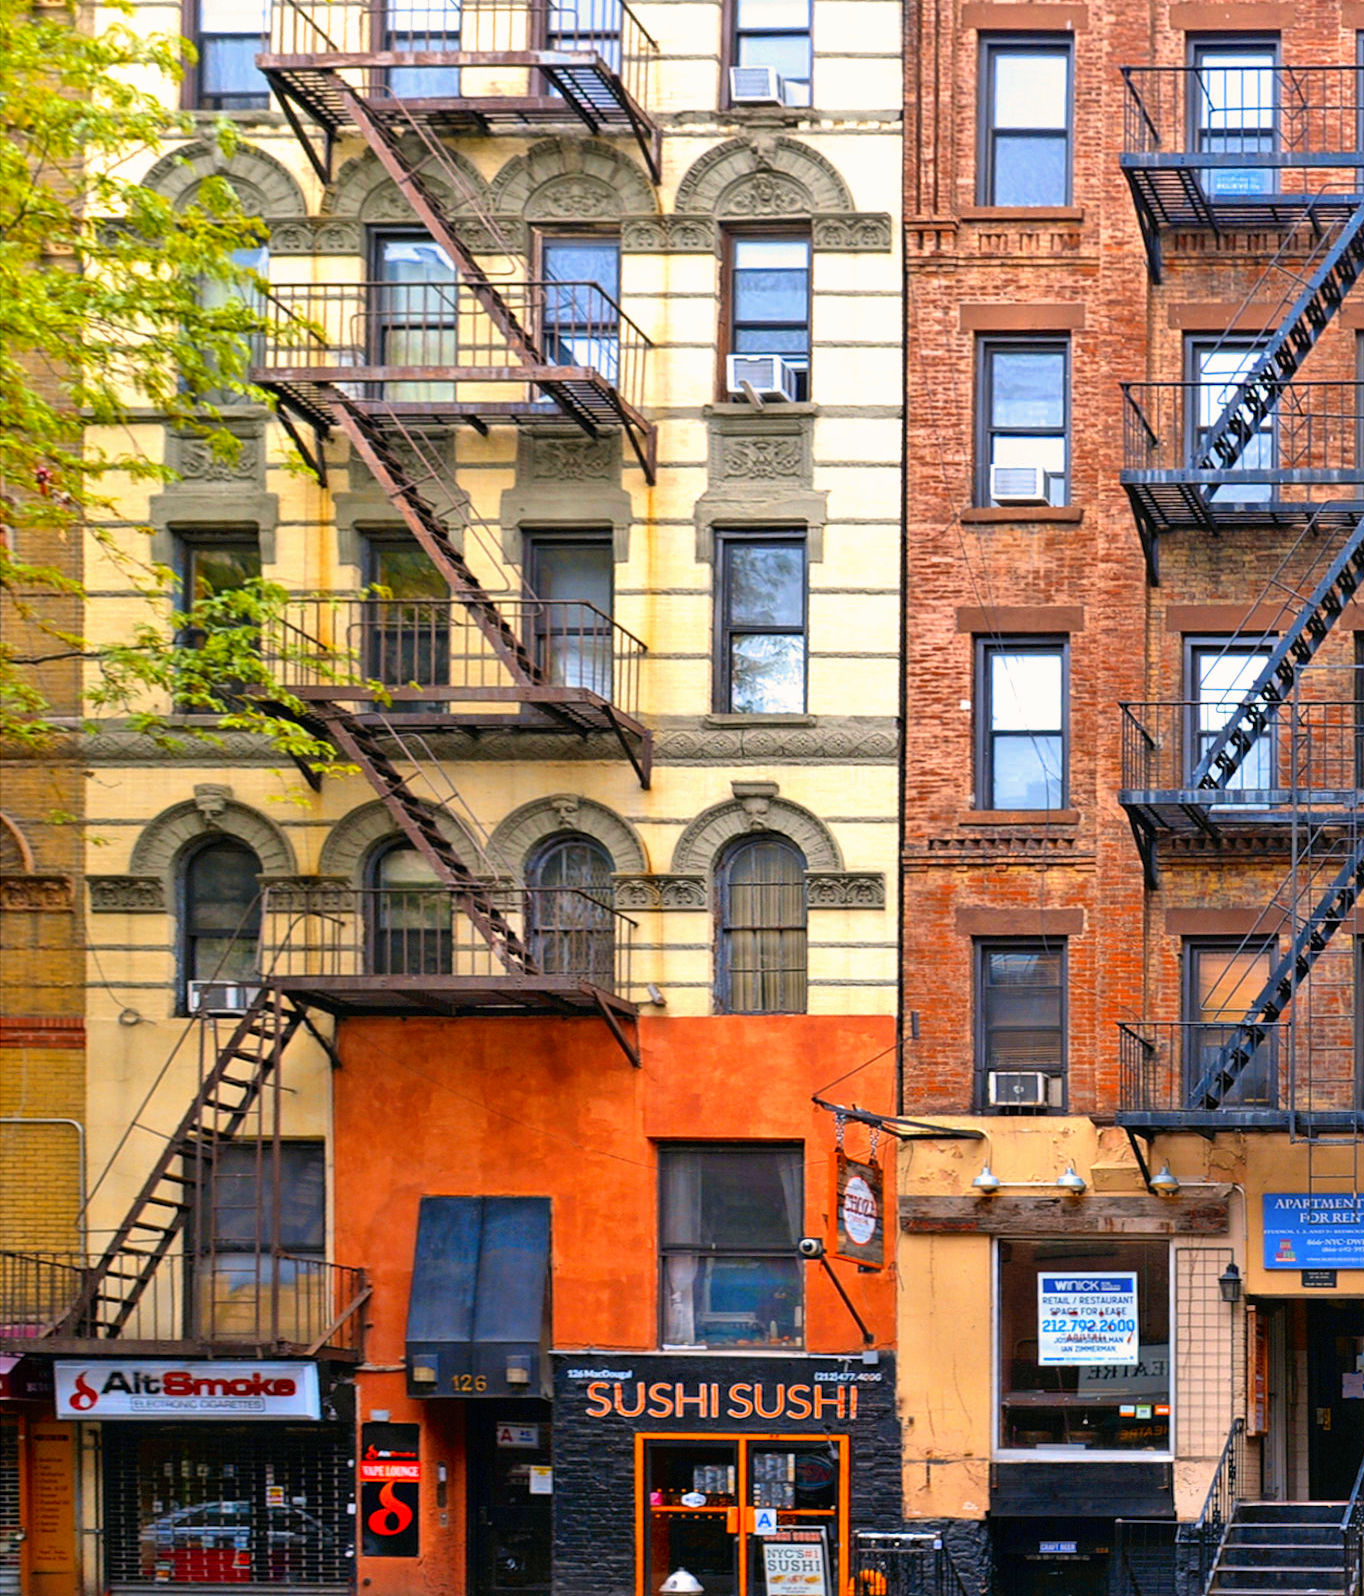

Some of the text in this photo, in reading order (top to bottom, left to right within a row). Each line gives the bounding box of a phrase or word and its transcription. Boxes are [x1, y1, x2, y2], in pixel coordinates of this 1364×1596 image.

[1300, 1212, 1329, 1223] FOR
[1042, 1296, 1070, 1304] RETAIL
[1079, 1296, 1134, 1304] RESTAURANT
[1081, 1307, 1098, 1315] FOR
[1042, 1319, 1135, 1333] 212.792.2600
[451, 1374, 488, 1392] 126
[585, 1381, 859, 1420] SUSHI SUSHI
[757, 1512, 772, 1528] A
[767, 1560, 822, 1572] SUSHI
